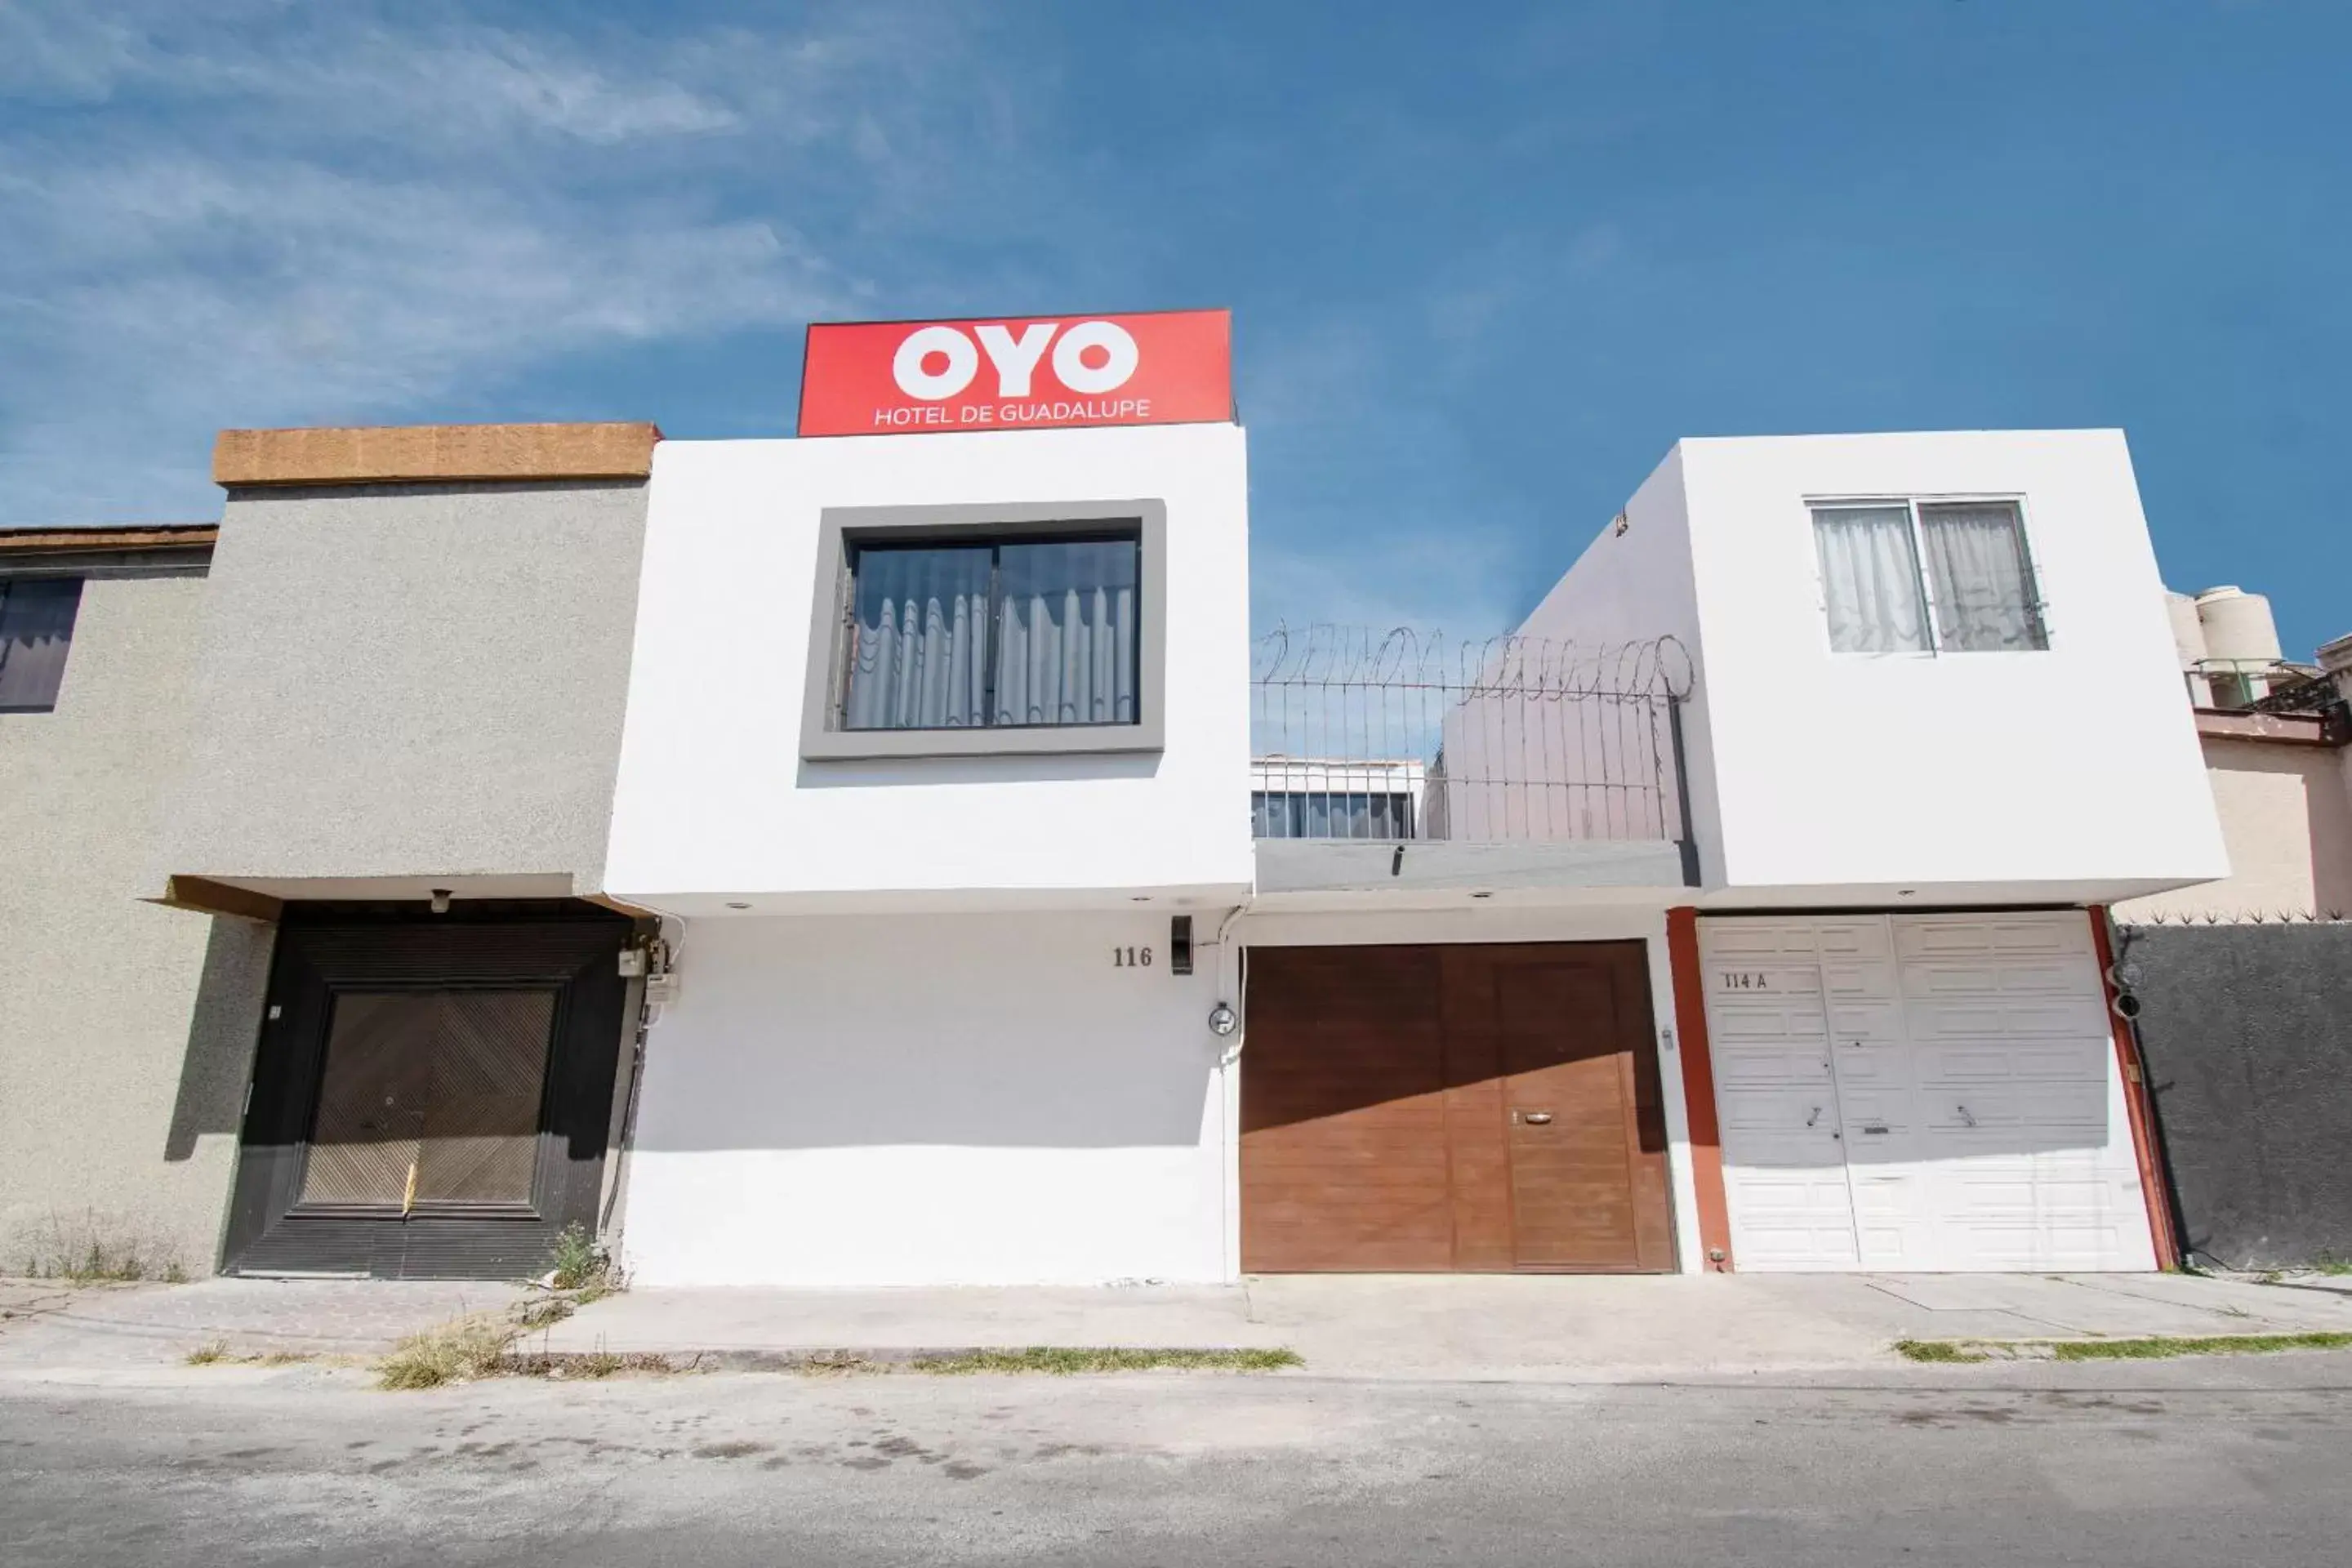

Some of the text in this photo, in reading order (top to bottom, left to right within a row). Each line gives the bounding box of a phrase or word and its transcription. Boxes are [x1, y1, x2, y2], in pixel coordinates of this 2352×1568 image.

[893, 321, 1139, 400] OYO
[875, 399, 1152, 425] HOTEL DE GUADALUPE
[1113, 947, 1152, 967] 116
[1725, 973, 1767, 988] 114 A
